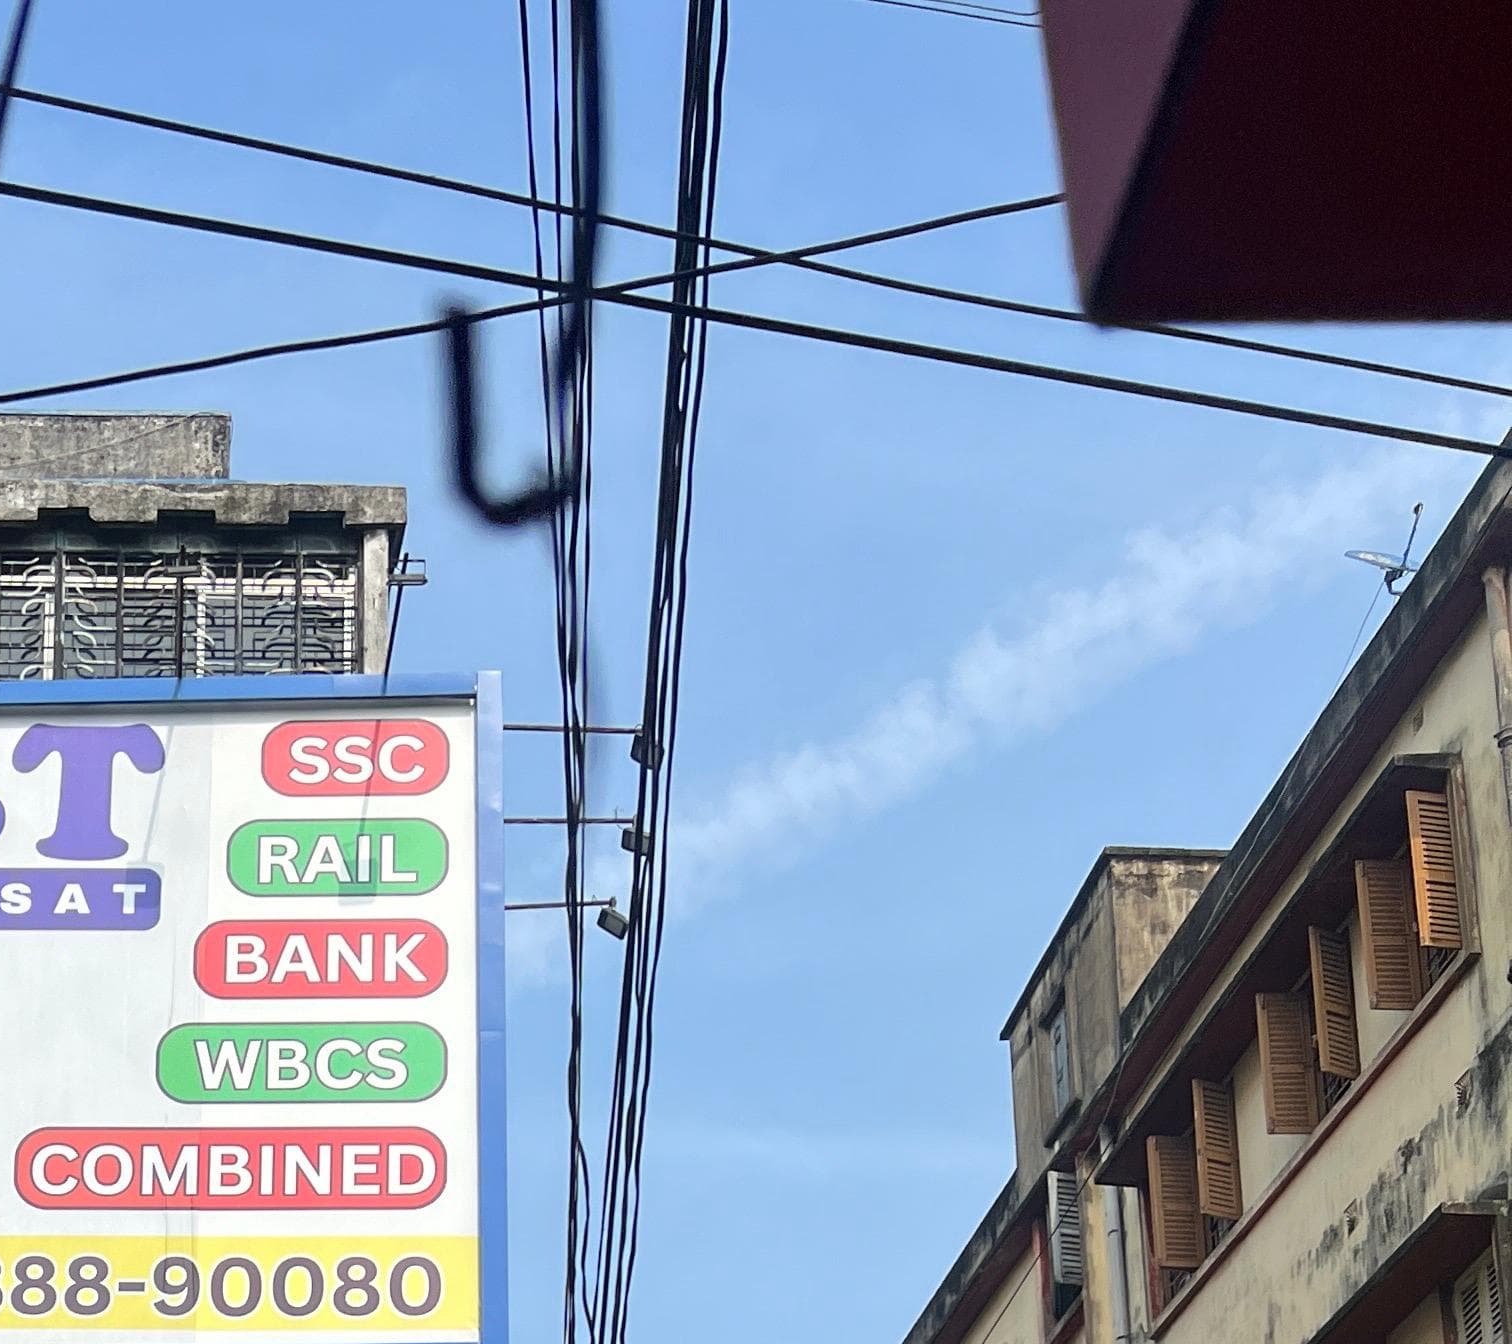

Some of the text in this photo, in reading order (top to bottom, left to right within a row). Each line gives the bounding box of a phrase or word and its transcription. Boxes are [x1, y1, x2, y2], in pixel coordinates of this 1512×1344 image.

[288, 735, 426, 785] SSC
[257, 834, 417, 885] RAIL
[224, 932, 428, 985] BANK
[196, 1038, 409, 1091] WBCS
[30, 1143, 437, 1198] COMBINED
